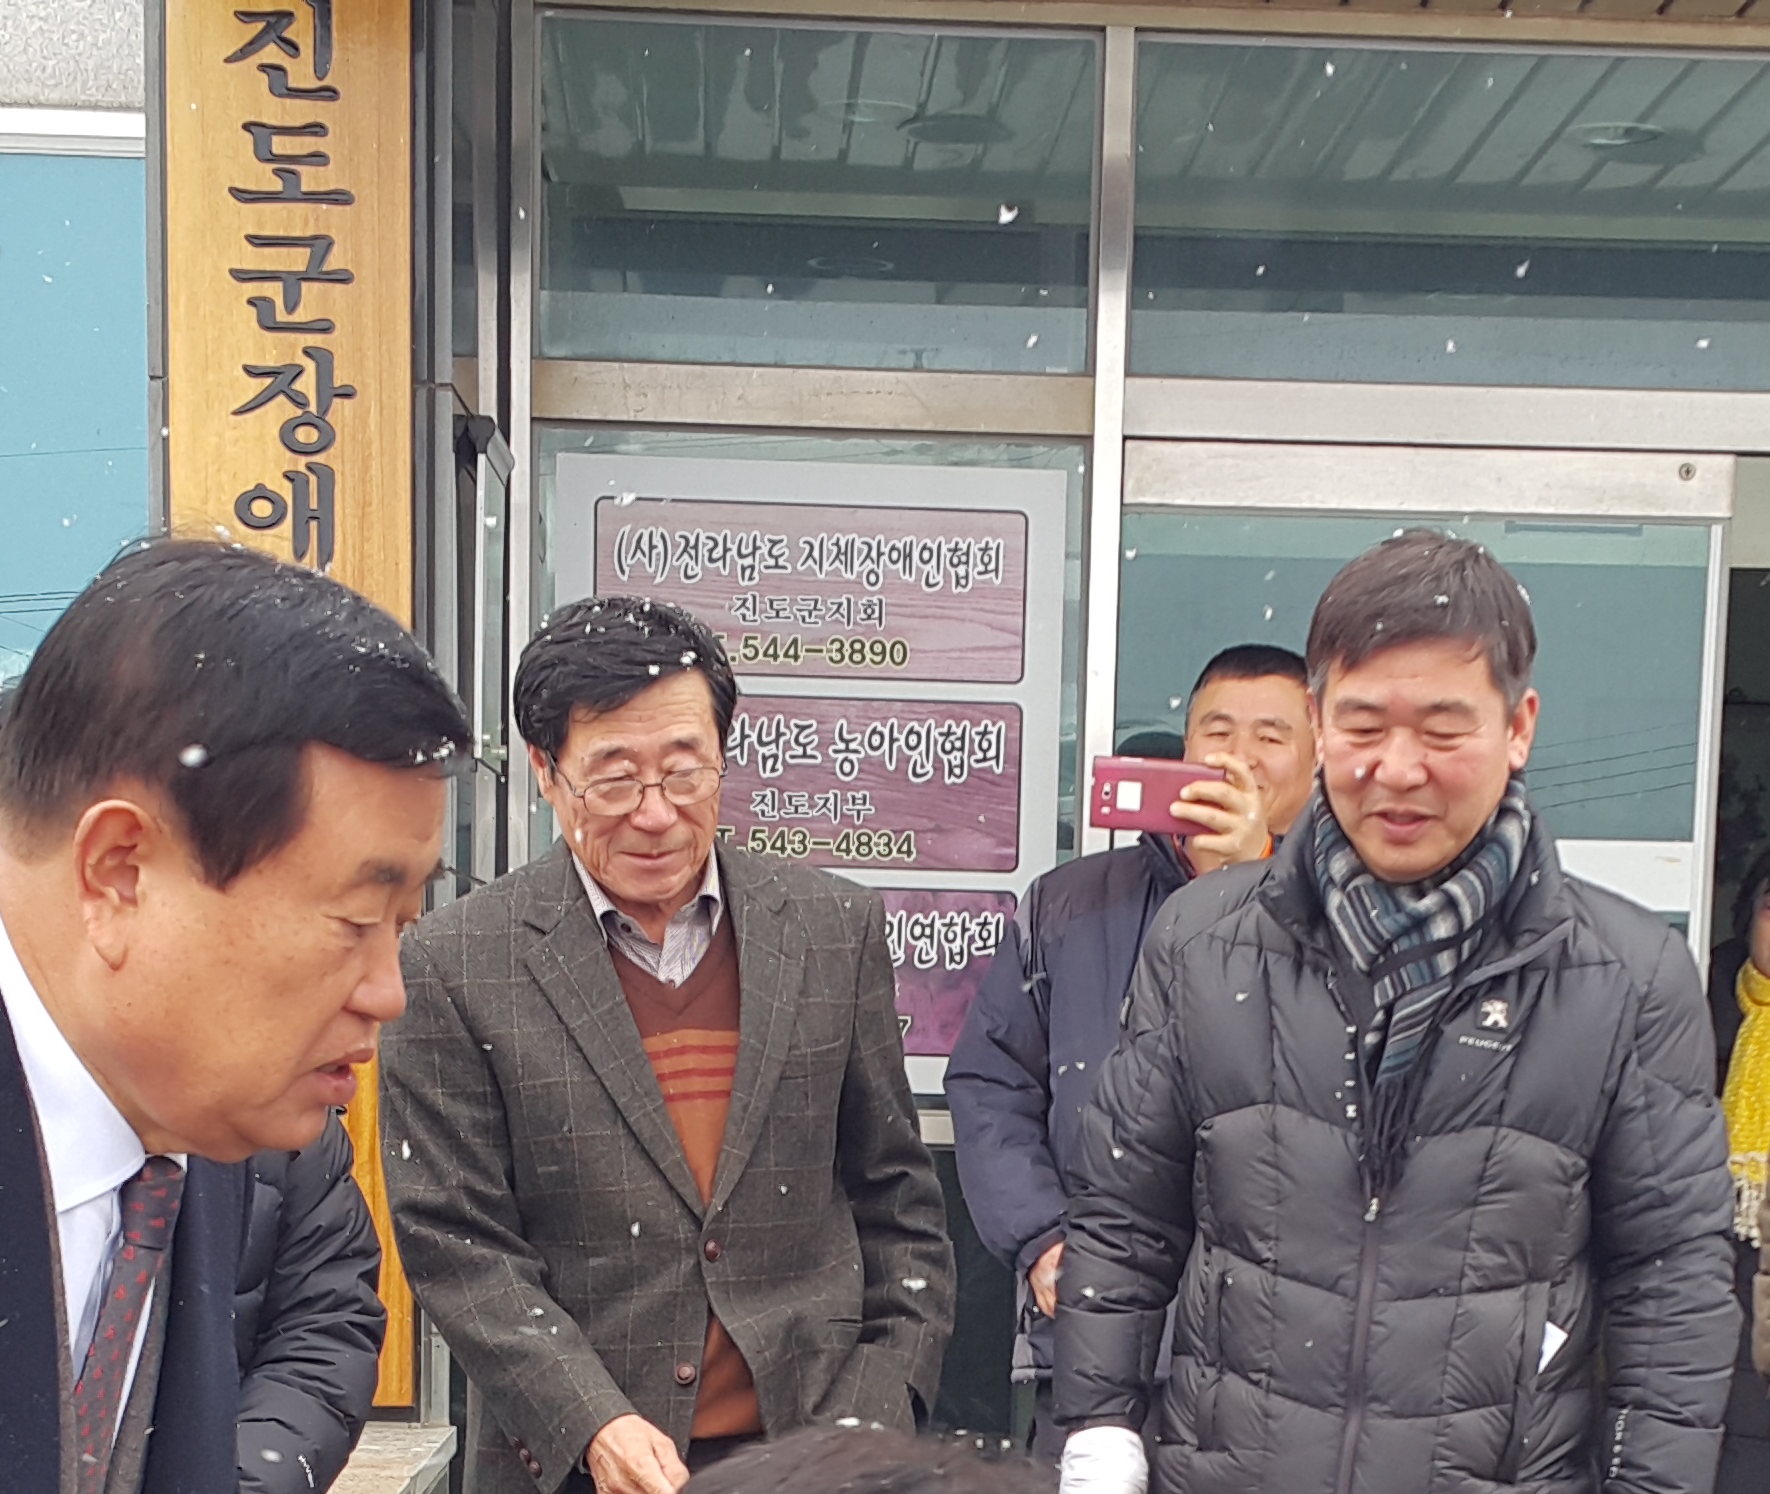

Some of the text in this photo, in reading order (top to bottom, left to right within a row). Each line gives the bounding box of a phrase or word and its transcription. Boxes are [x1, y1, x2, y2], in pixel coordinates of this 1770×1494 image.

[614, 526, 1004, 593] (사)전라남도 지체장애인협회
[731, 592, 886, 630] 진도군지회
[829, 718, 1006, 784] 농아인협회
[751, 788, 875, 824] 진도지부
